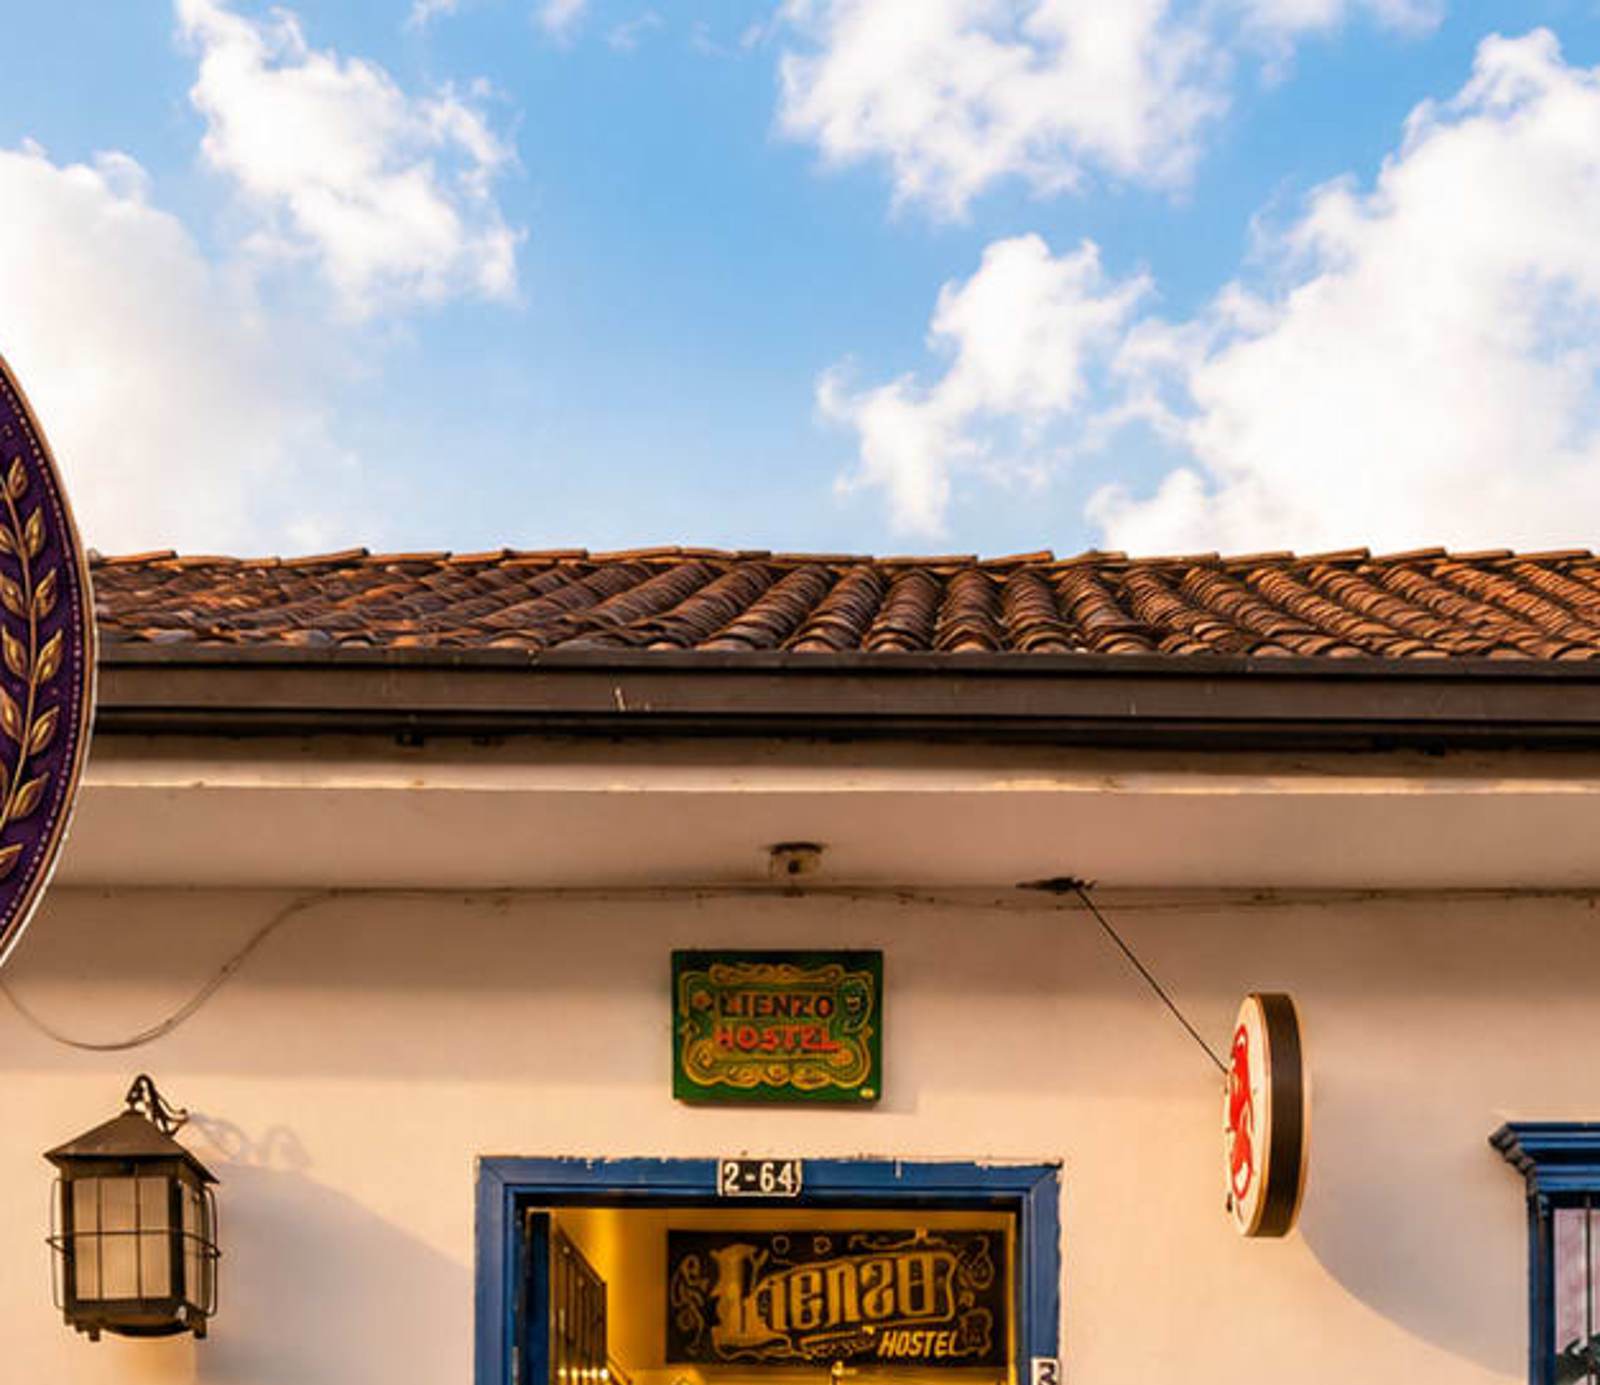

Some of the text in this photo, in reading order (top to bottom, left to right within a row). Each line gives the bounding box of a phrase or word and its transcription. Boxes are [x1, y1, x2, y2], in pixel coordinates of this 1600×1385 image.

[720, 992, 834, 1019] LIENZO
[723, 1162, 795, 1192] 2-64
[877, 1330, 957, 1357] HOSTEL
